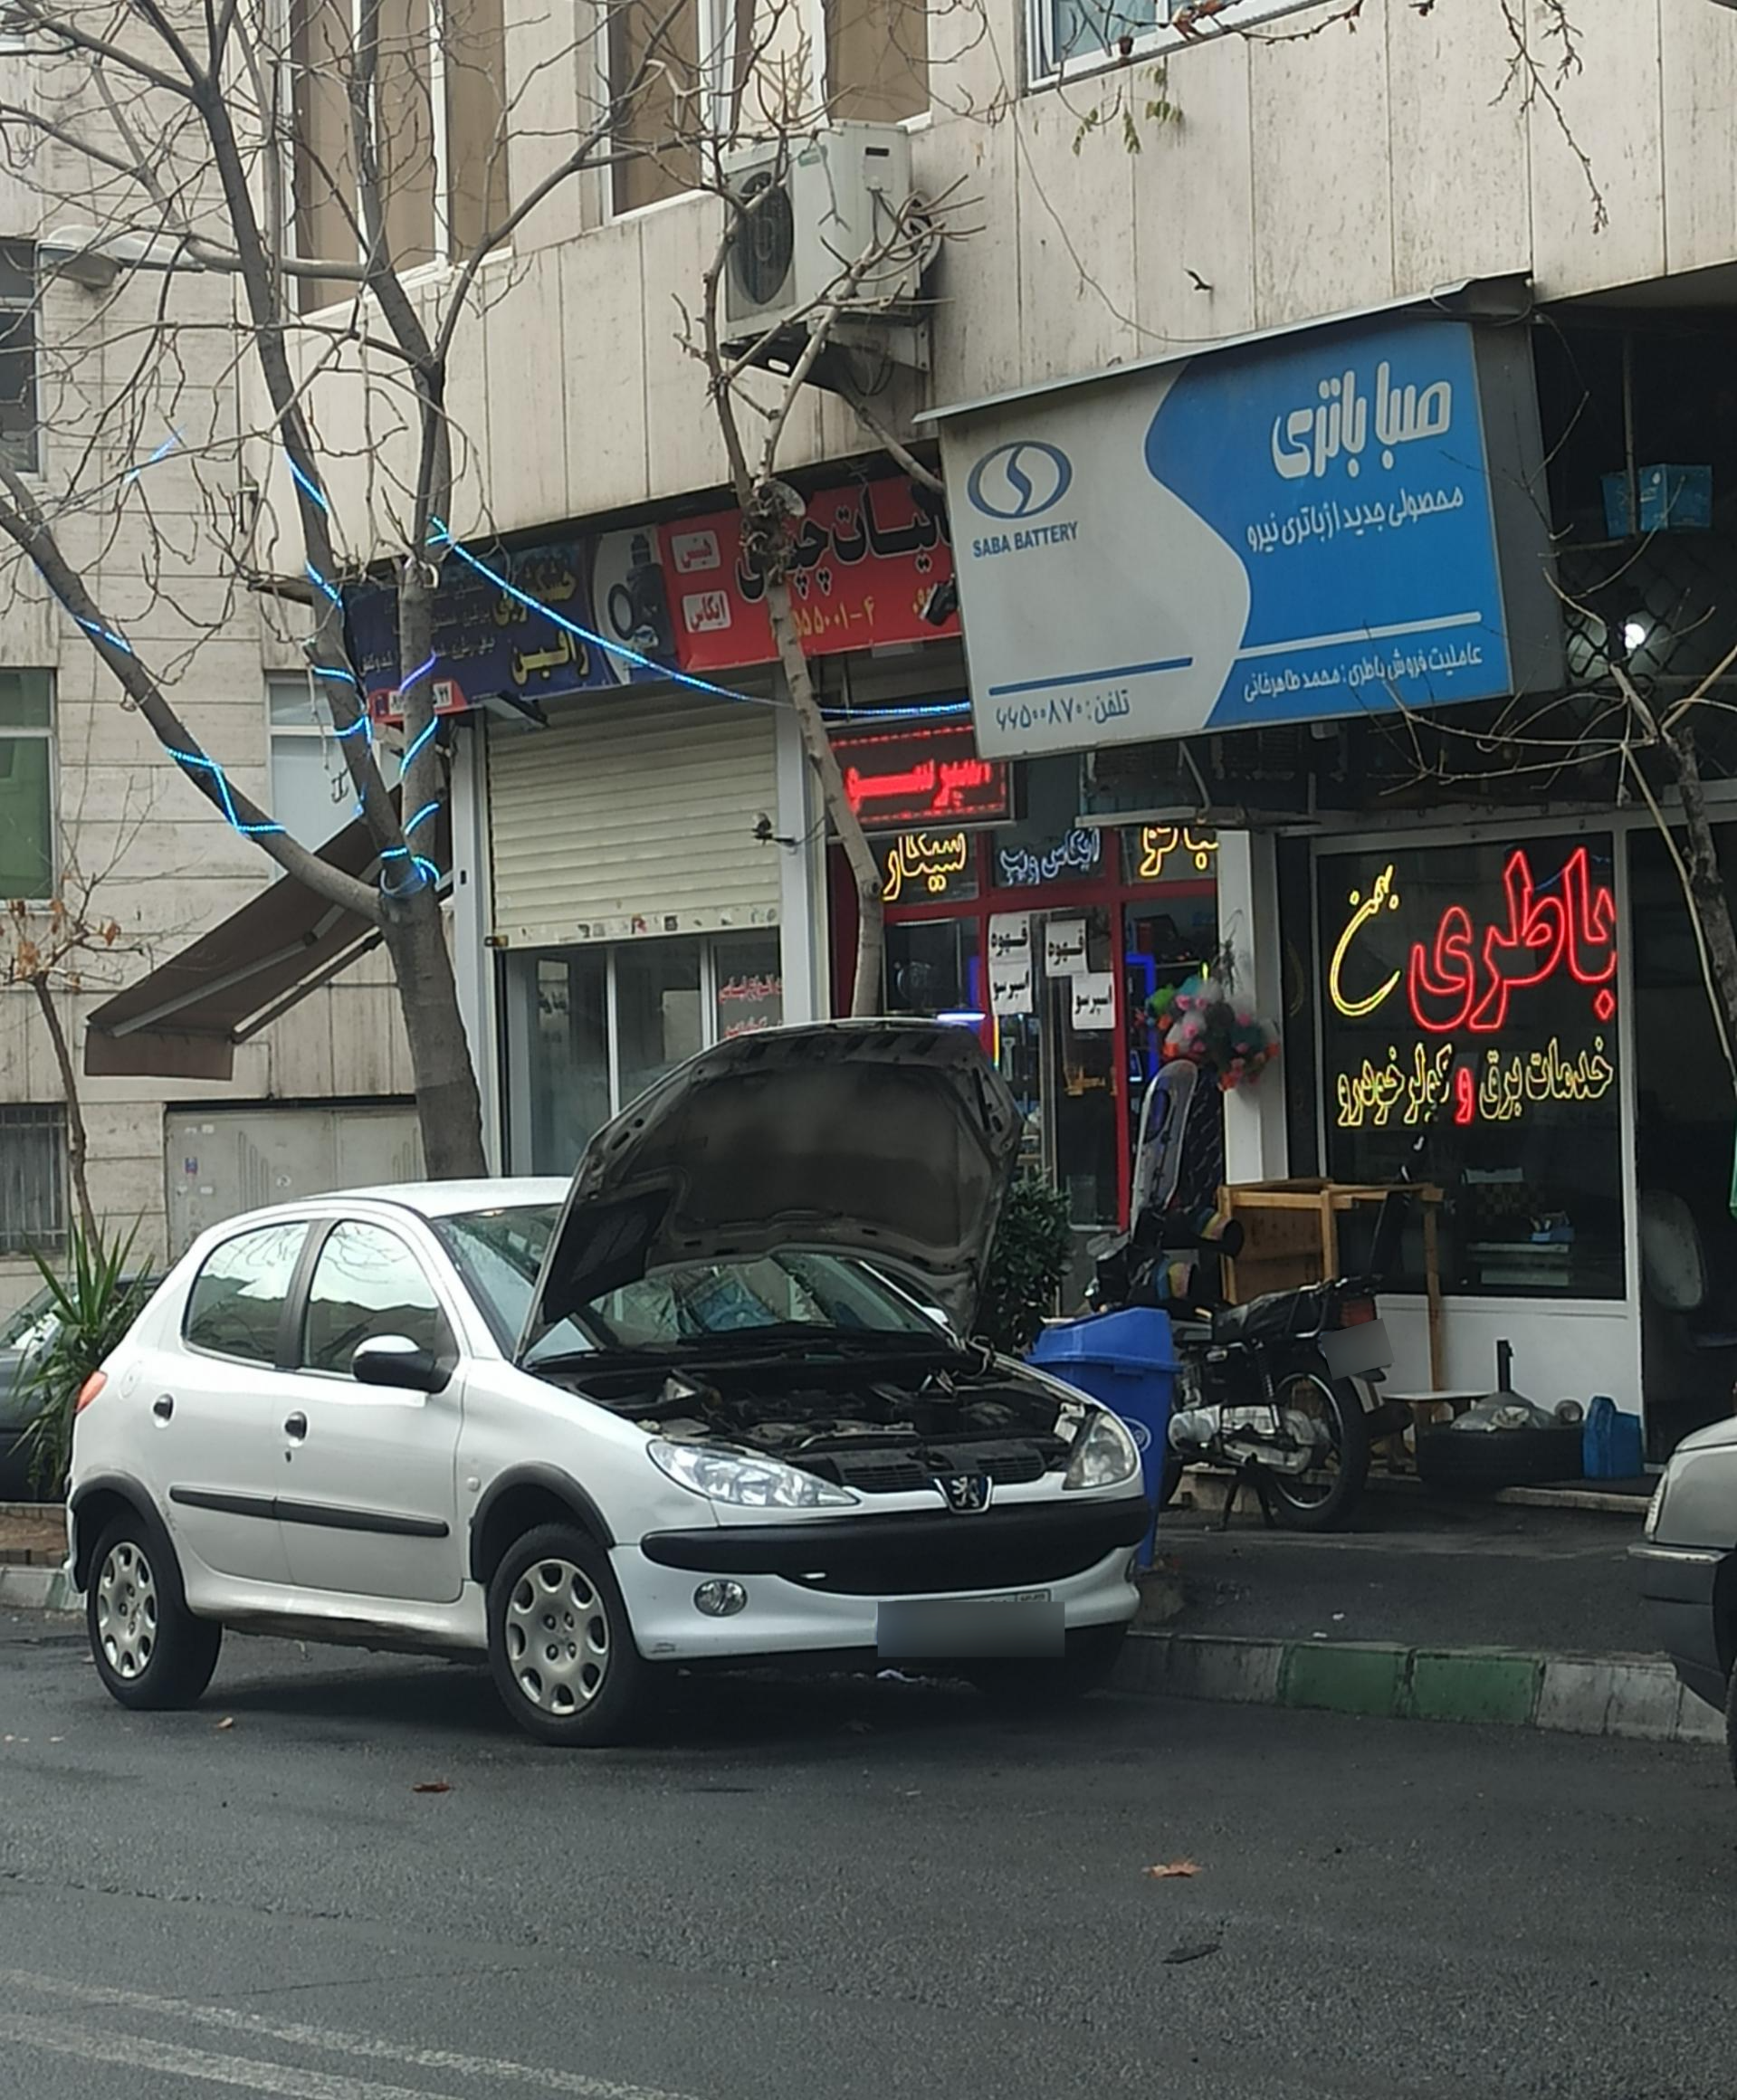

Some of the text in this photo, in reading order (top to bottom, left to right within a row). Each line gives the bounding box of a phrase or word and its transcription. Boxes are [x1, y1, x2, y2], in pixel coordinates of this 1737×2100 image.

[1272, 361, 1453, 479] صبا باتری
[972, 521, 1079, 558] SABA BATTERY
[1246, 486, 1465, 553] محصولی جدید از باتری نیرو
[1303, 666, 1341, 690] محمد
[1389, 646, 1426, 682] فروش
[1428, 642, 1483, 676] عاملیت
[997, 696, 1083, 731] ۶۶۵۰۰۸۷۰
[845, 758, 993, 815] اسپرسو
[990, 920, 1028, 958] قهوه
[1048, 929, 1085, 966] قهوه
[1329, 845, 1618, 1033] باطری بهمن
[1337, 1045, 1405, 1127] خودرو
[1454, 1065, 1475, 1125] و
[1479, 1049, 1522, 1121] برق
[1526, 1036, 1614, 1101] خدمات
